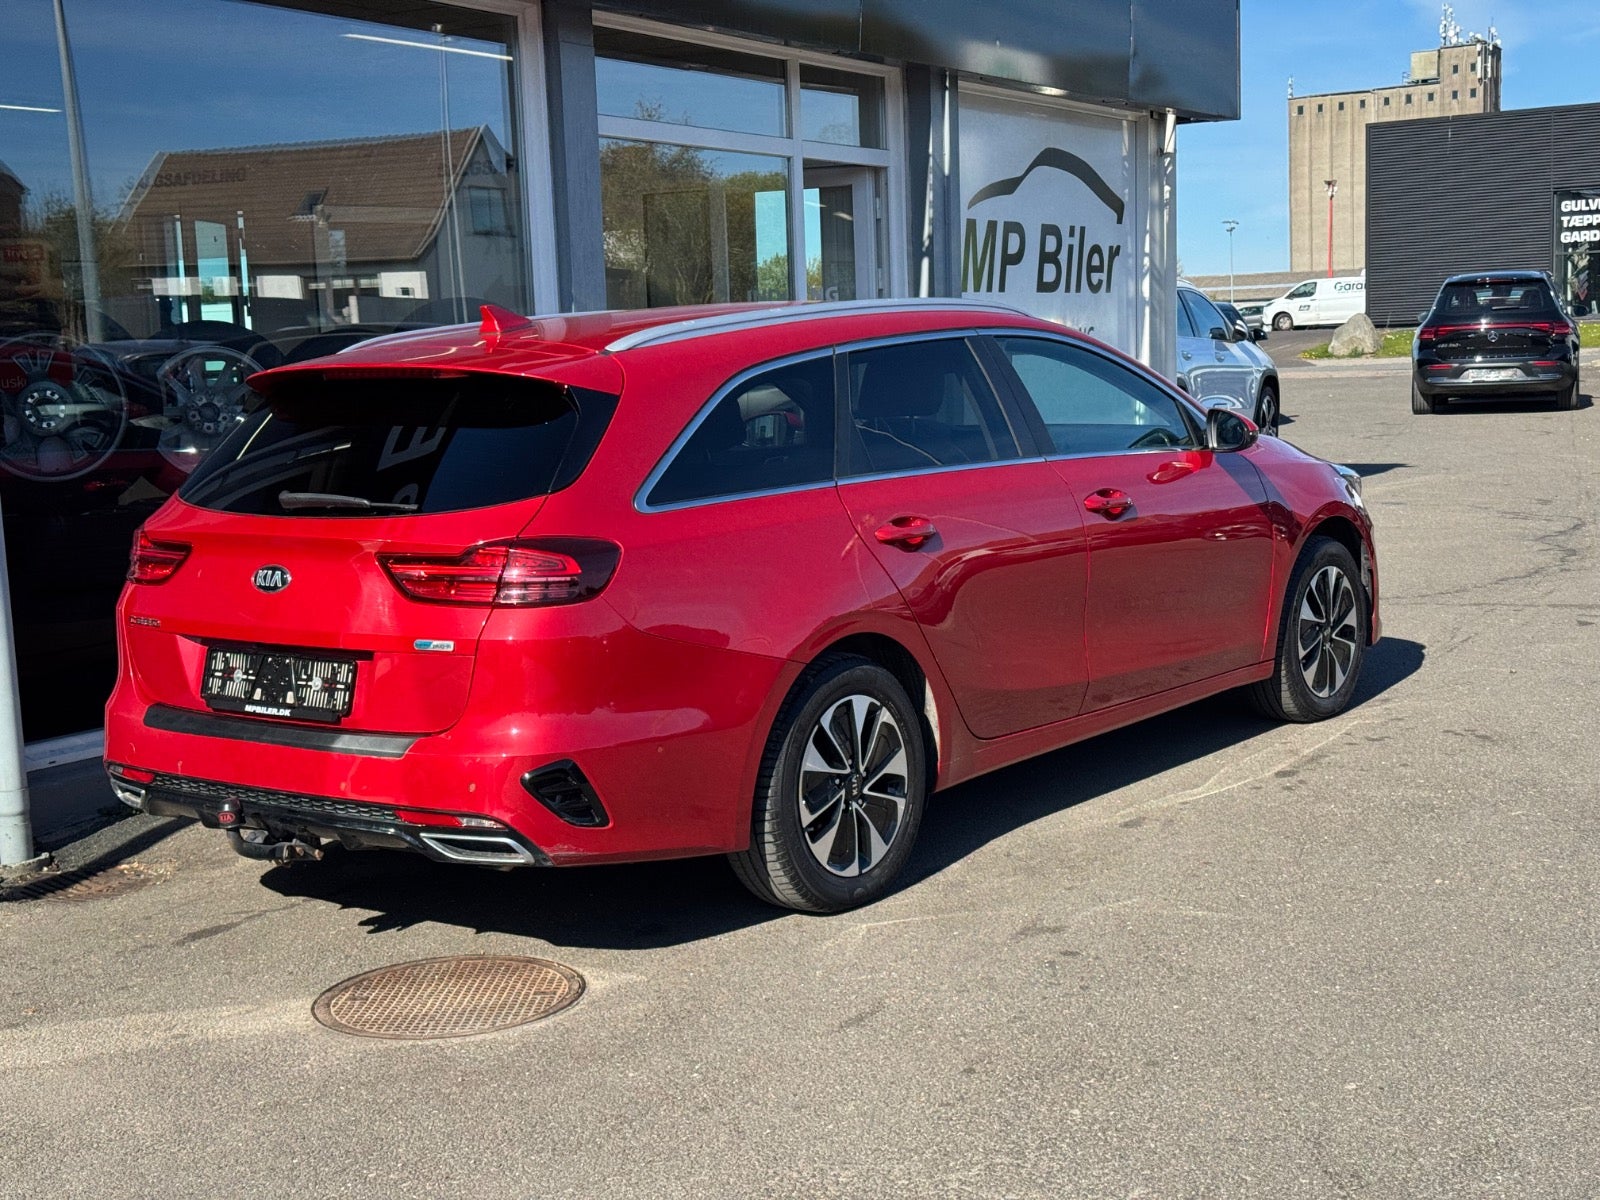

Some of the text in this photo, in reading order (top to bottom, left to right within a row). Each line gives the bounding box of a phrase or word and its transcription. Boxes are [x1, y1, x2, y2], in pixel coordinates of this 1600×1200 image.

[1561, 199, 1600, 212] GULV
[961, 218, 1121, 294] MP Biler
[1334, 281, 1365, 291] Gara
[256, 570, 282, 587] KIA
[244, 704, 291, 717] MPBILER.DK
